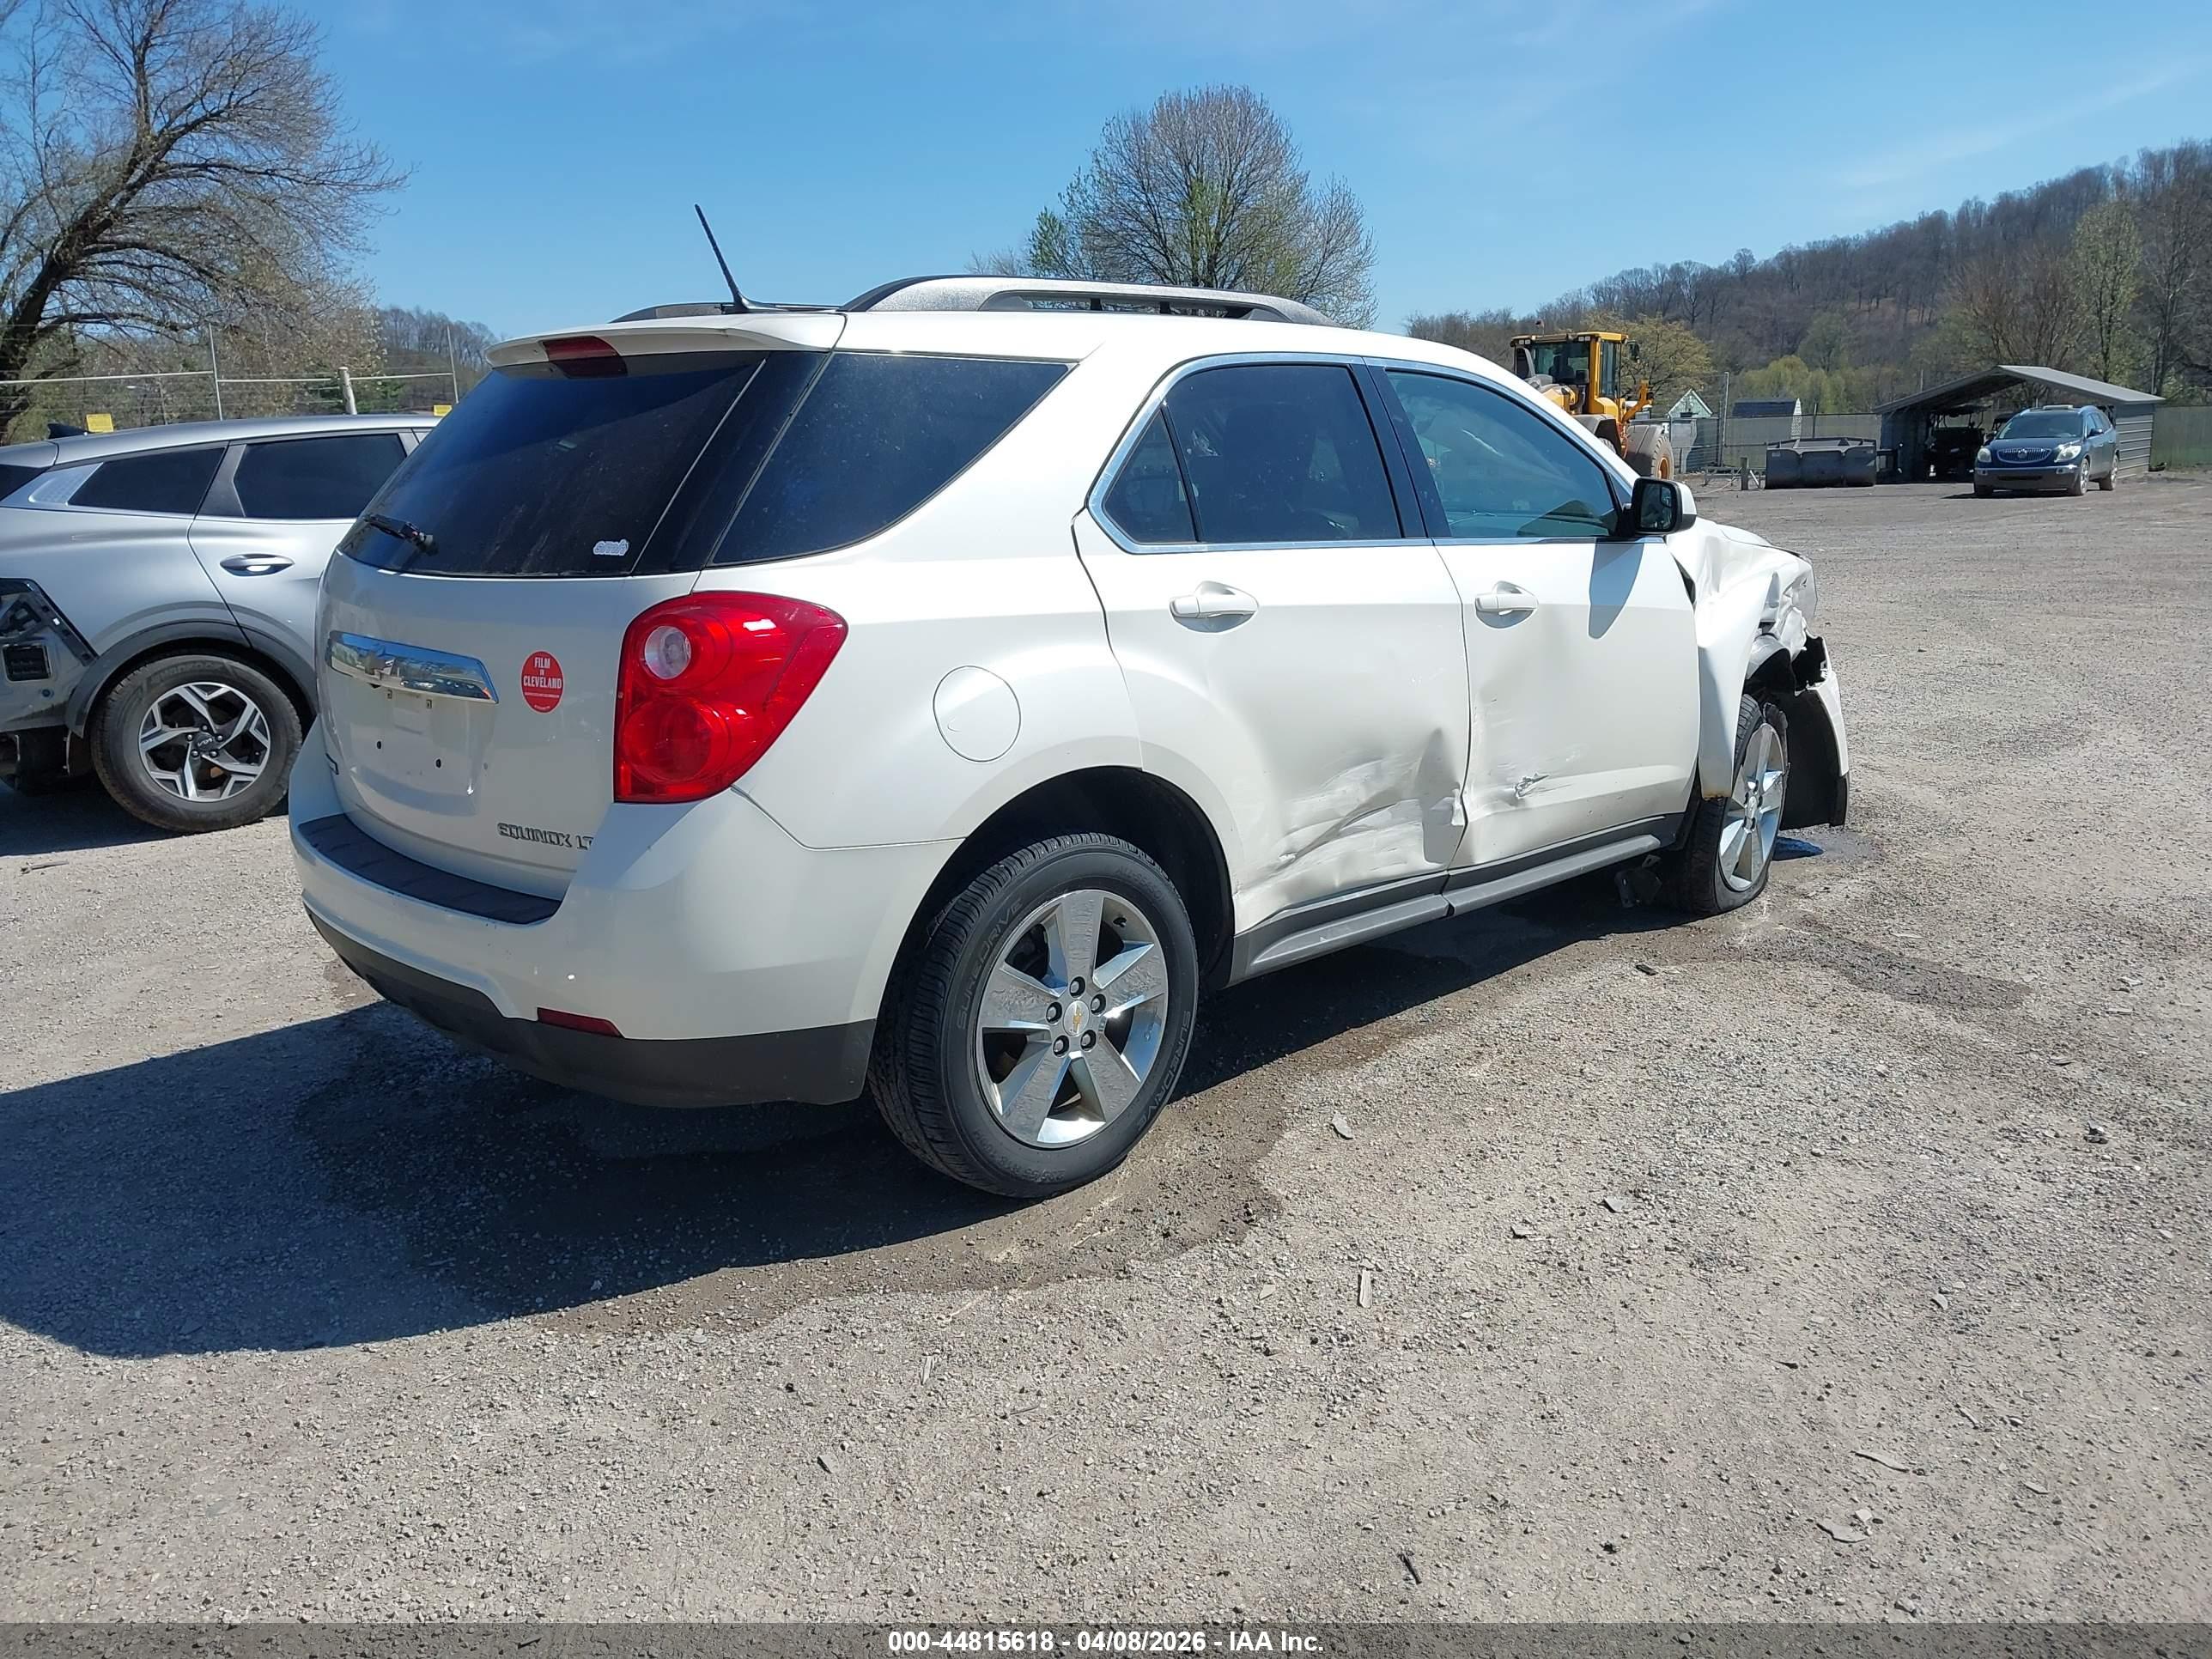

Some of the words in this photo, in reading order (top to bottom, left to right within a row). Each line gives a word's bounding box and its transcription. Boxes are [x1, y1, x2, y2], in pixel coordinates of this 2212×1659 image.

[534, 657, 550, 669] FILM
[523, 676, 562, 689] CLEVELAND
[497, 823, 573, 848] EQUINOX
[957, 897, 1023, 1030] SUREDRIVE
[1138, 1010, 1191, 1131] SUREDRIVE
